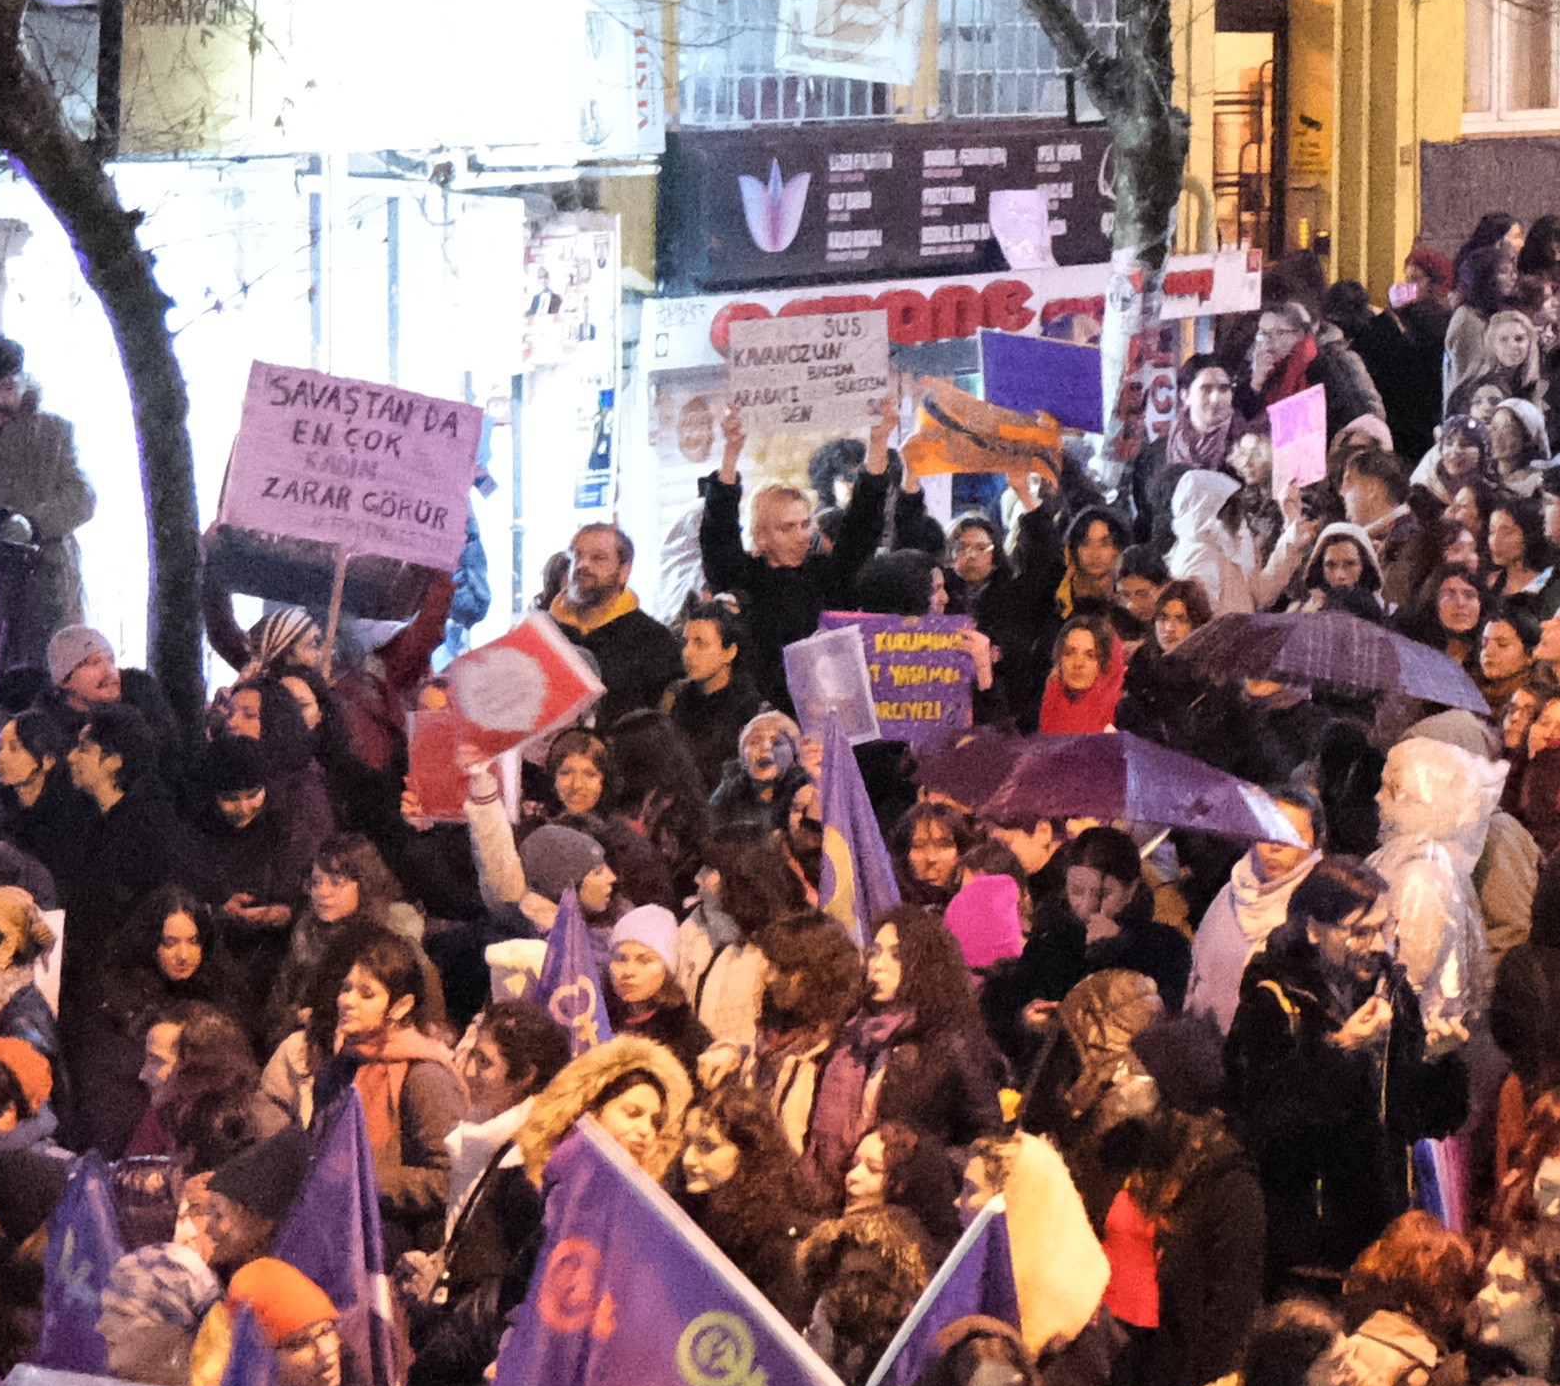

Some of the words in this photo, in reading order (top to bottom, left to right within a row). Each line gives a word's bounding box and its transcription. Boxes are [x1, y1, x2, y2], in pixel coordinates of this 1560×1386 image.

[291, 417, 333, 449] EN
[342, 427, 404, 459] ÇOK
[261, 475, 354, 514] ZARAR
[361, 489, 450, 531] GÖRÜR
